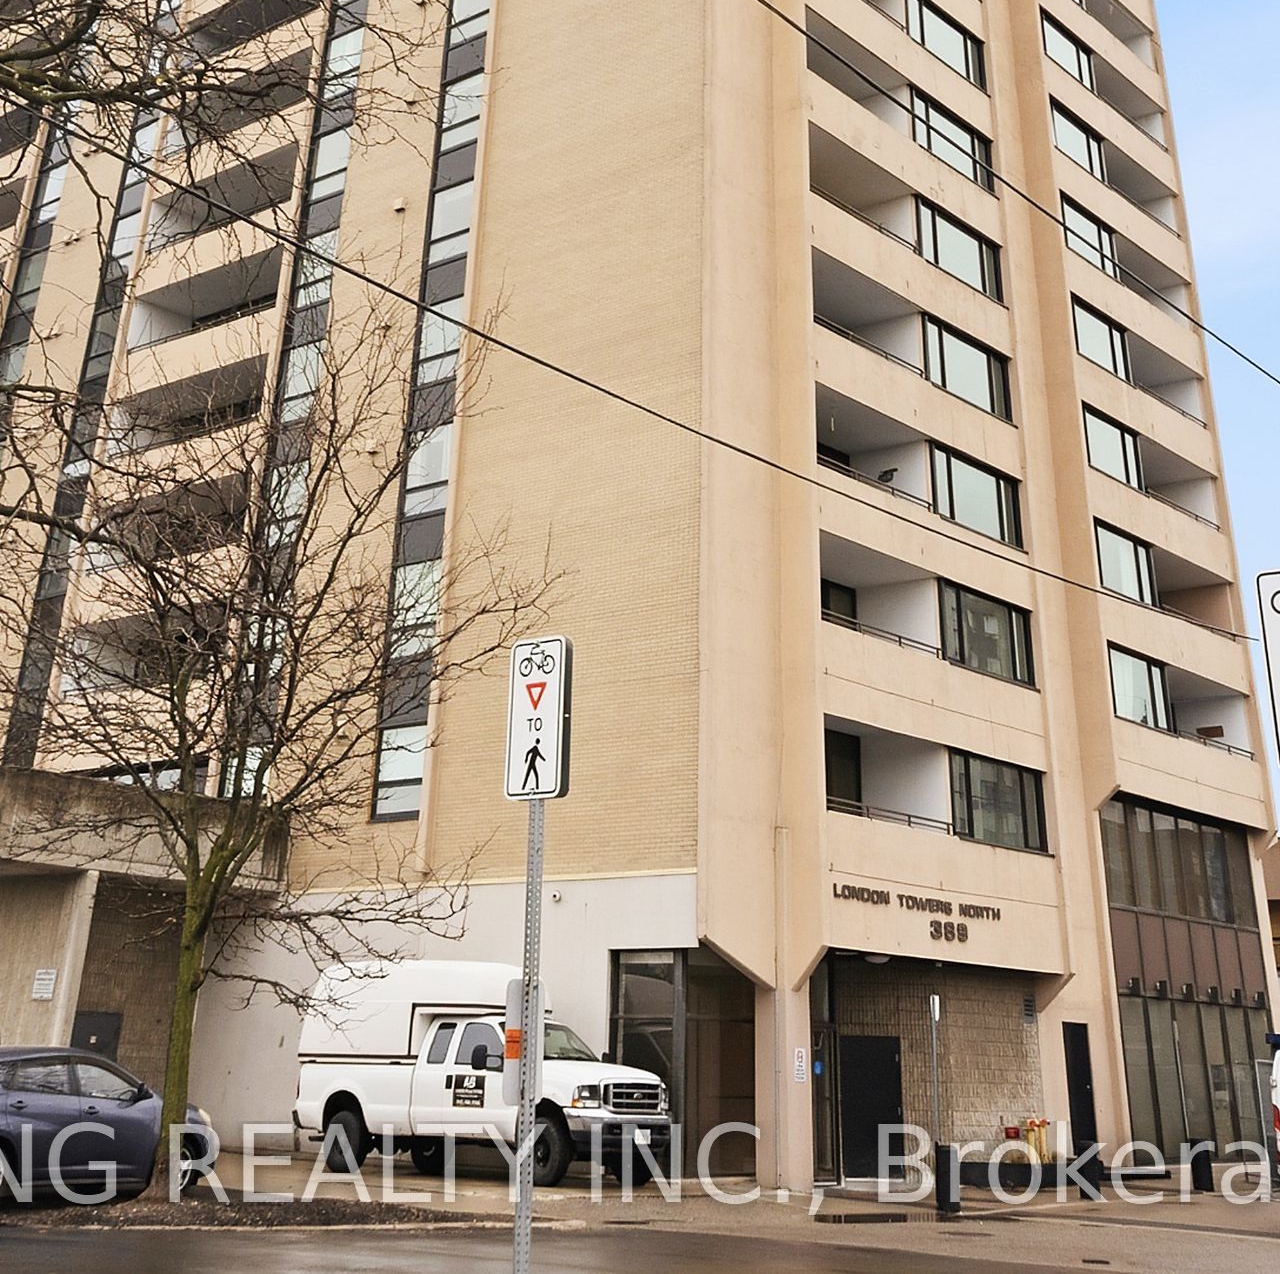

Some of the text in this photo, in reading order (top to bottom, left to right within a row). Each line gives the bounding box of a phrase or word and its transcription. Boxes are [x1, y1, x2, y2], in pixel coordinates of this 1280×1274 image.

[527, 717, 543, 732] TO
[833, 883, 1001, 921] LONDON TOWERS NORTH
